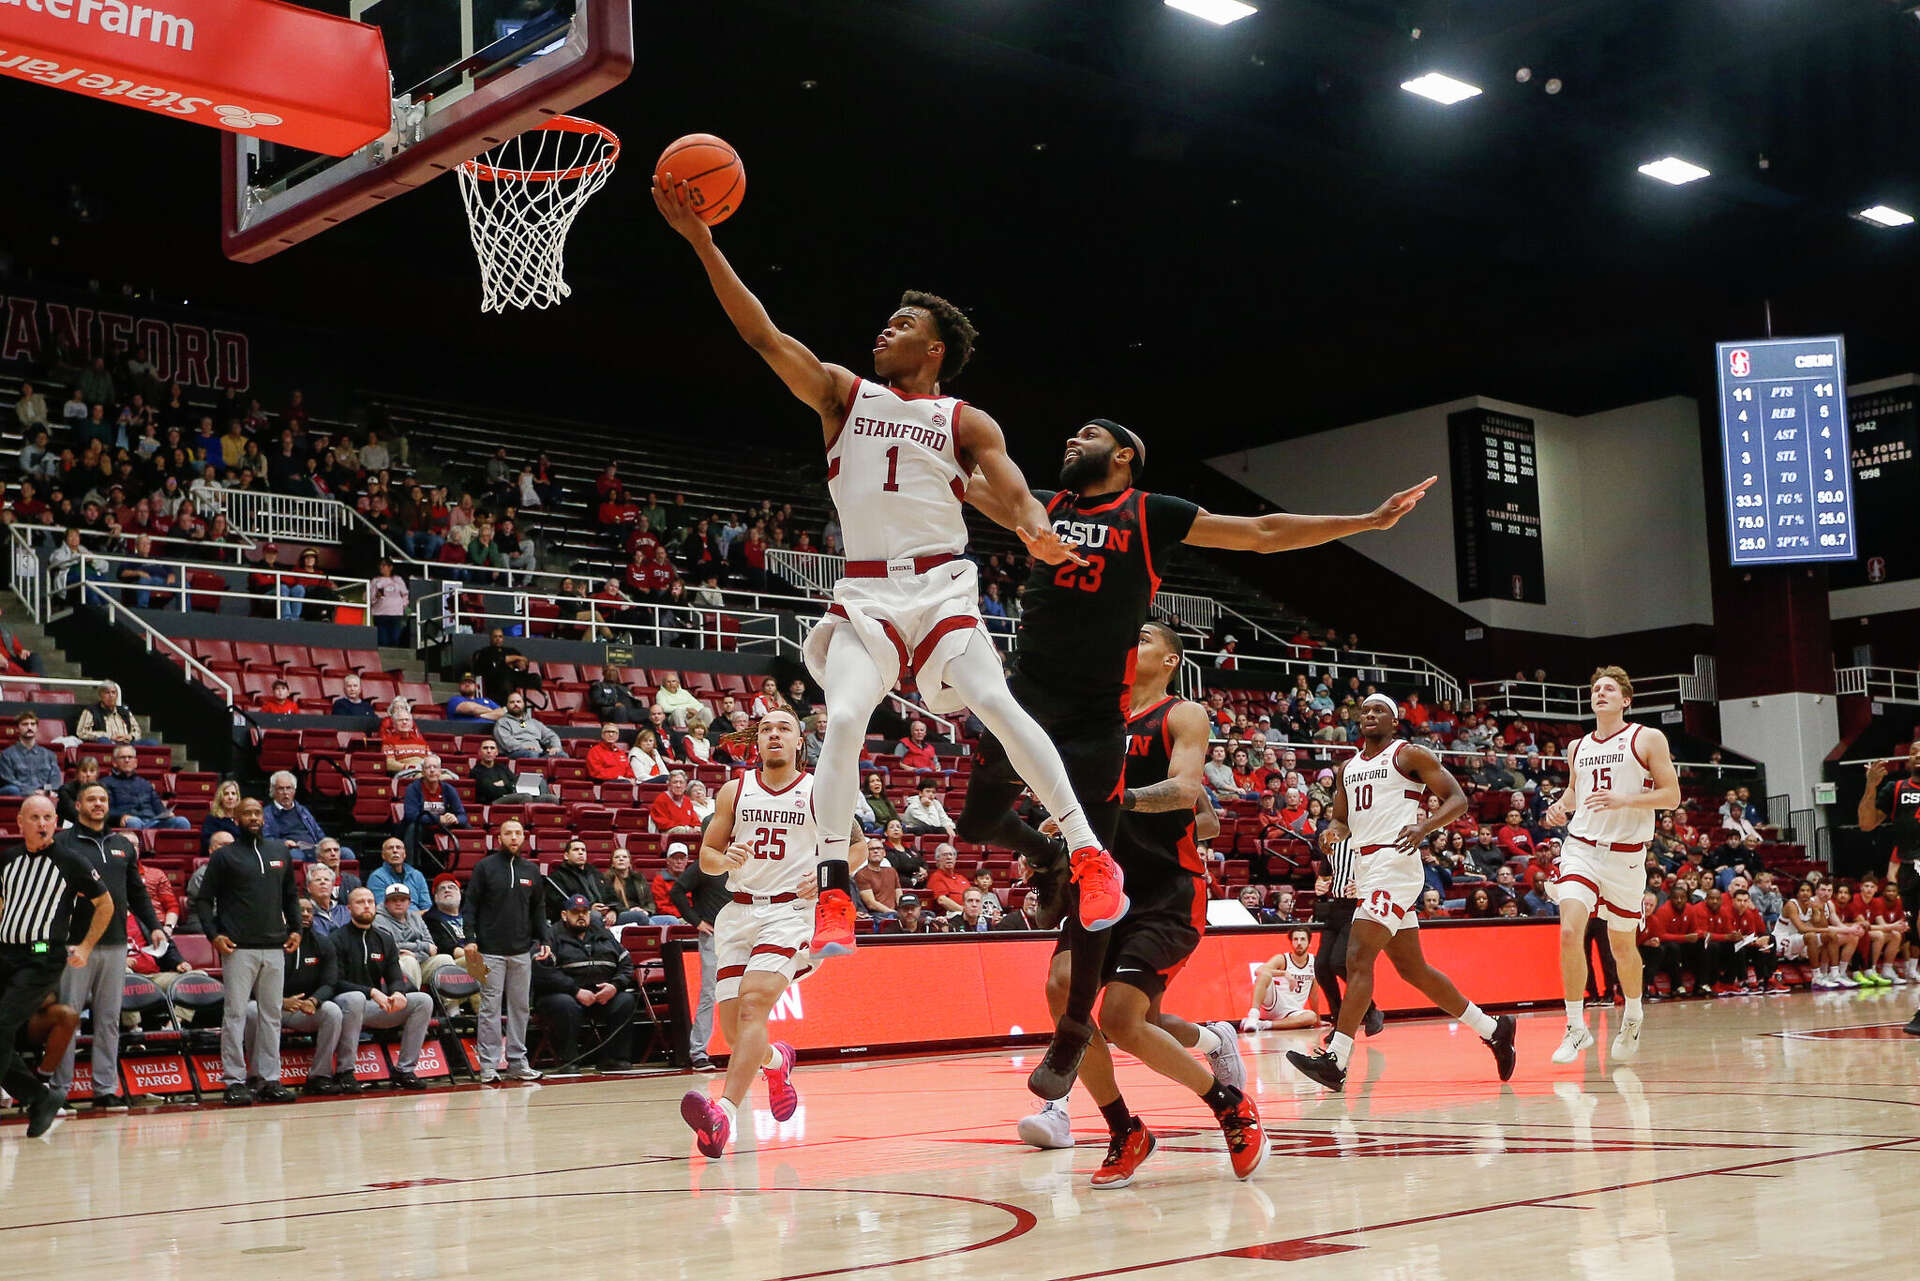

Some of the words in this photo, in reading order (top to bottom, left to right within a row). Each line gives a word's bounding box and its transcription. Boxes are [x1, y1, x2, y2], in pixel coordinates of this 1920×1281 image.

[0, 50, 213, 115] StateFar
[0, 295, 250, 392] ANFORD
[1732, 387, 1752, 402] 11
[1770, 386, 1794, 398] PTS
[1813, 383, 1833, 398] 11
[1738, 409, 1748, 422] 4
[1770, 407, 1796, 419] REB
[854, 416, 947, 452] STANFORD
[1741, 430, 1750, 443] 1
[1773, 429, 1798, 441] AST
[1820, 426, 1831, 439] 4
[1741, 452, 1751, 465] 3
[1776, 450, 1797, 462] STL
[1824, 448, 1832, 460] 1
[883, 445, 899, 492] 1
[1743, 473, 1752, 486] 2
[1780, 472, 1797, 483] TO
[1823, 469, 1834, 482] 3
[1735, 494, 1763, 508] 33.3
[1817, 490, 1845, 504] 50.0
[1737, 515, 1765, 529] 75.0
[1052, 519, 1132, 553] CSUN
[1739, 537, 1766, 551] 25.0
[1054, 551, 1106, 593] 23
[1579, 753, 1624, 768] STANFORD
[1344, 768, 1388, 787] STANFORD
[1591, 767, 1612, 792] 15
[1354, 784, 1373, 812] 10
[1901, 793, 1920, 804] CS
[741, 809, 805, 826] STANFORD
[753, 827, 787, 861] 25
[355, 1050, 377, 1061] LLS
[132, 1062, 179, 1075] WELLS
[355, 1062, 380, 1074] RGO
[414, 1059, 440, 1071] RGO
[135, 1073, 183, 1089] FARGO
